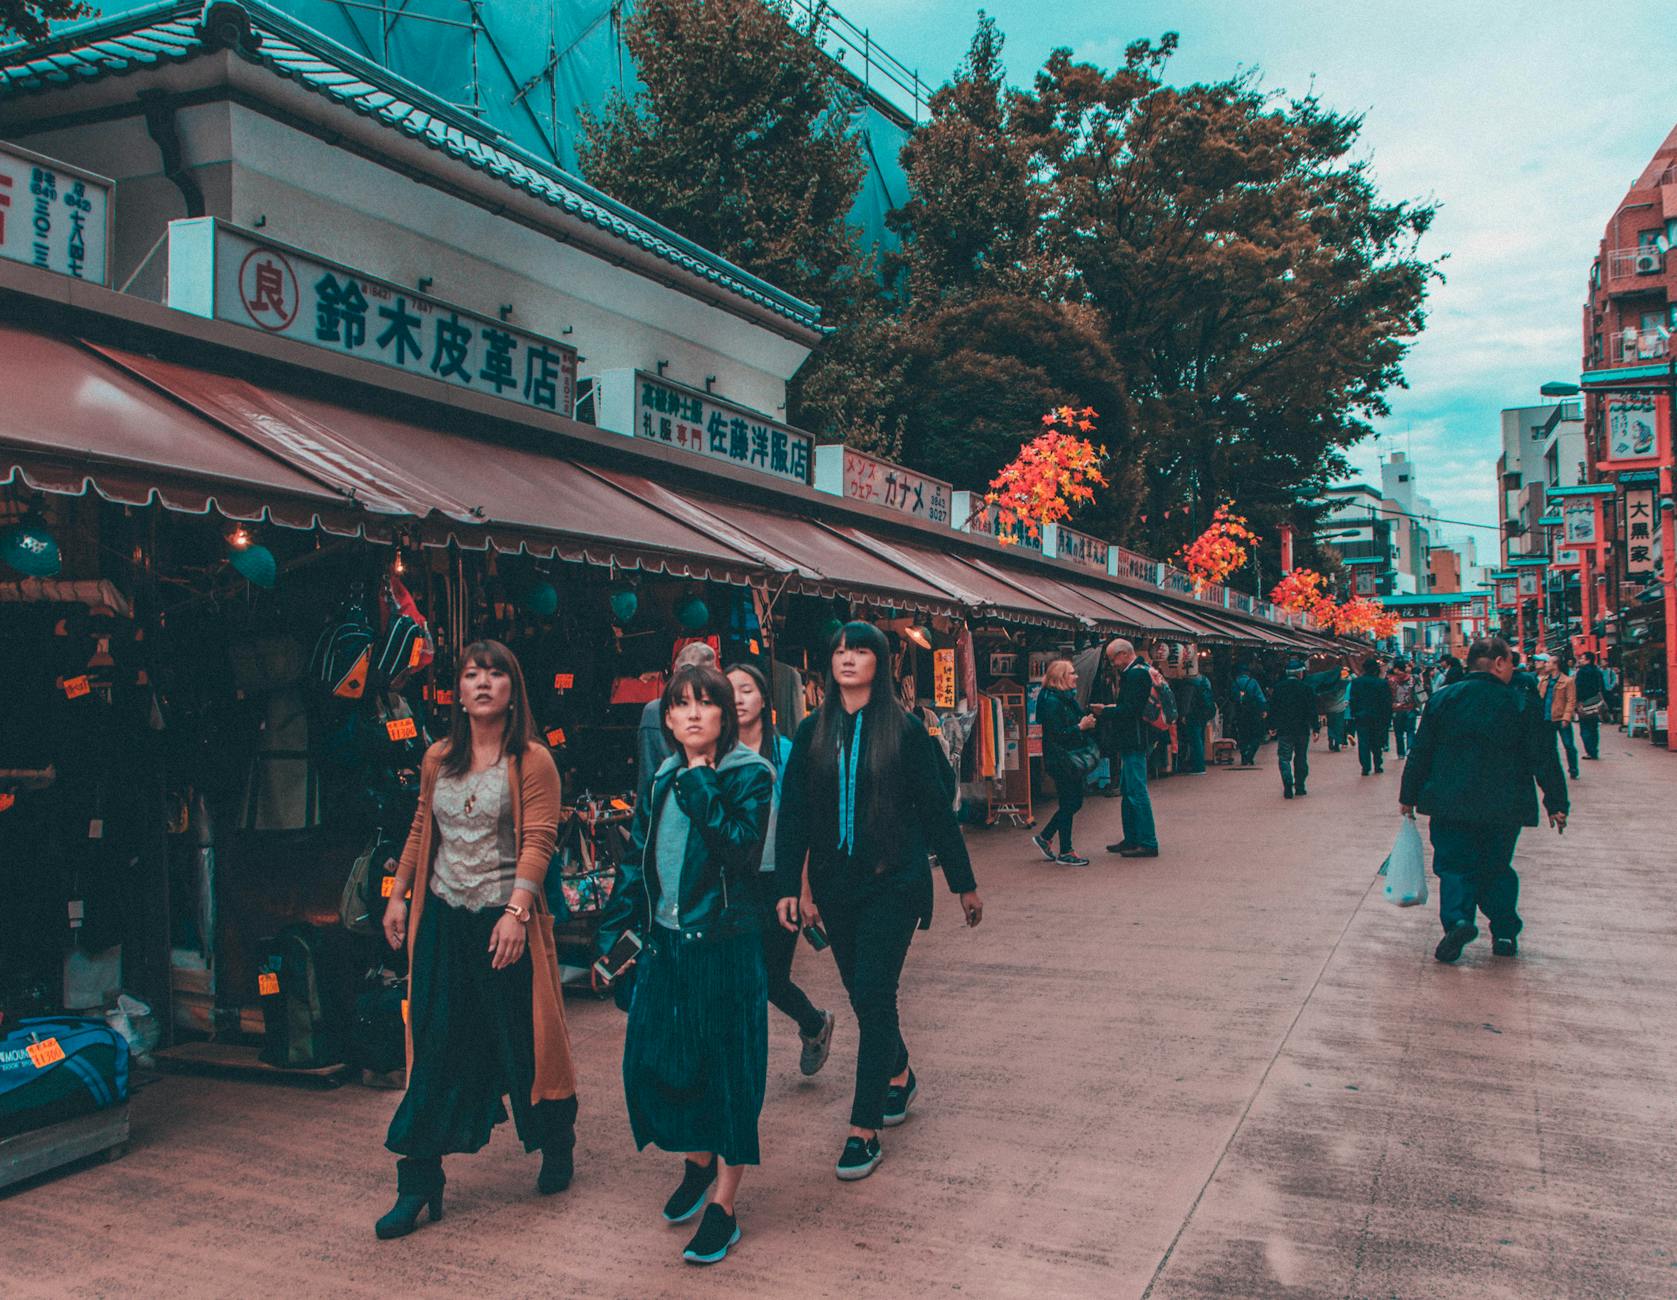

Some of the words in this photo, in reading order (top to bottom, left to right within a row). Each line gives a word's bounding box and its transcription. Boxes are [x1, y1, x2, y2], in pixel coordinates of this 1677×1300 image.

[313, 271, 561, 411] 鈴木皮革店
[707, 410, 808, 481] 佐藤洋服店
[847, 456, 877, 480] メンズ
[885, 472, 924, 513] カナメ
[1630, 500, 1652, 563] 大黒家
